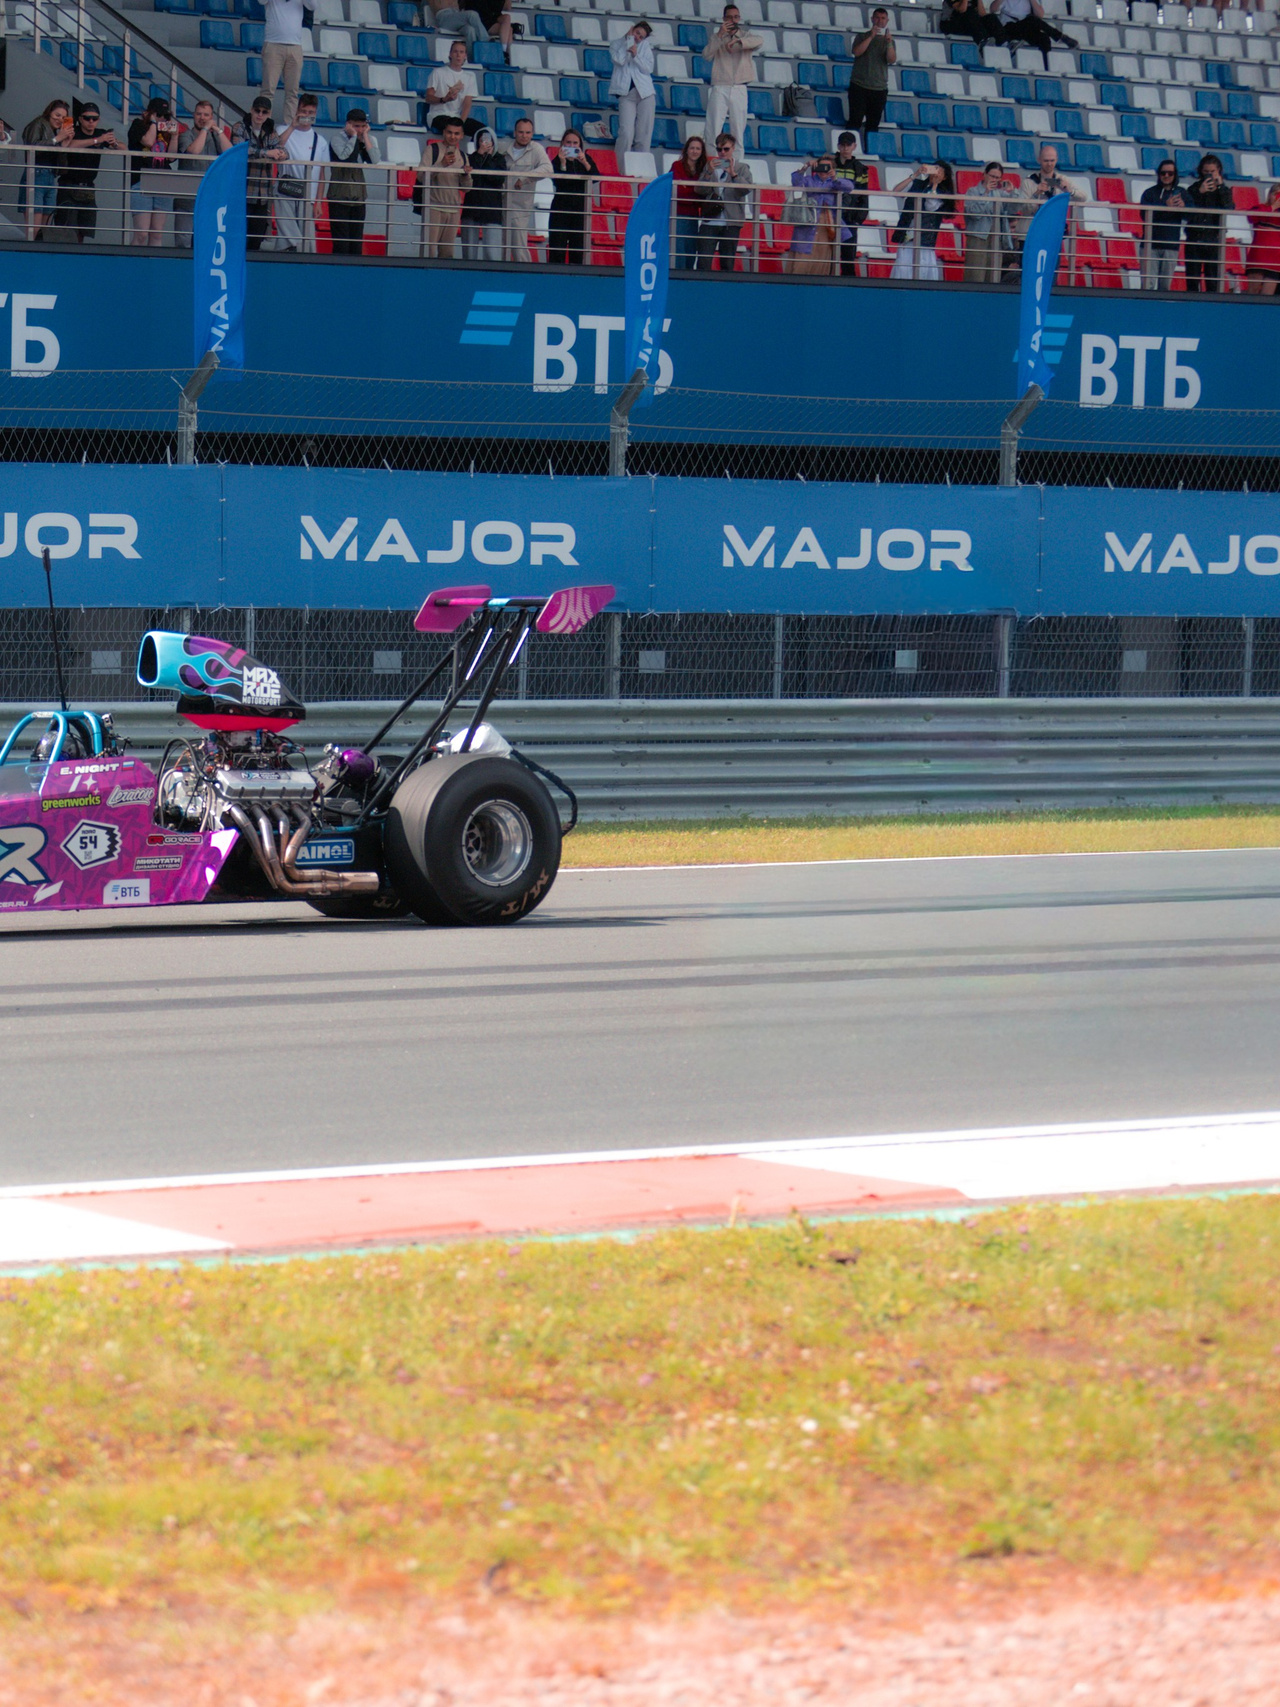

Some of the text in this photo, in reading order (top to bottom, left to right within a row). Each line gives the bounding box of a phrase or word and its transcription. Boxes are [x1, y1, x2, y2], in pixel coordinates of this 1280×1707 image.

[1079, 334, 1201, 410] ВТБ
[300, 515, 579, 566] MAJOR
[723, 525, 974, 572] MAJOR
[243, 666, 280, 684] MAX
[242, 696, 280, 706] MOTORSPORT
[75, 763, 119, 774] NIGHT
[42, 794, 100, 811] greenworks
[79, 835, 97, 849] 54
[121, 887, 140, 897] ВТБ
